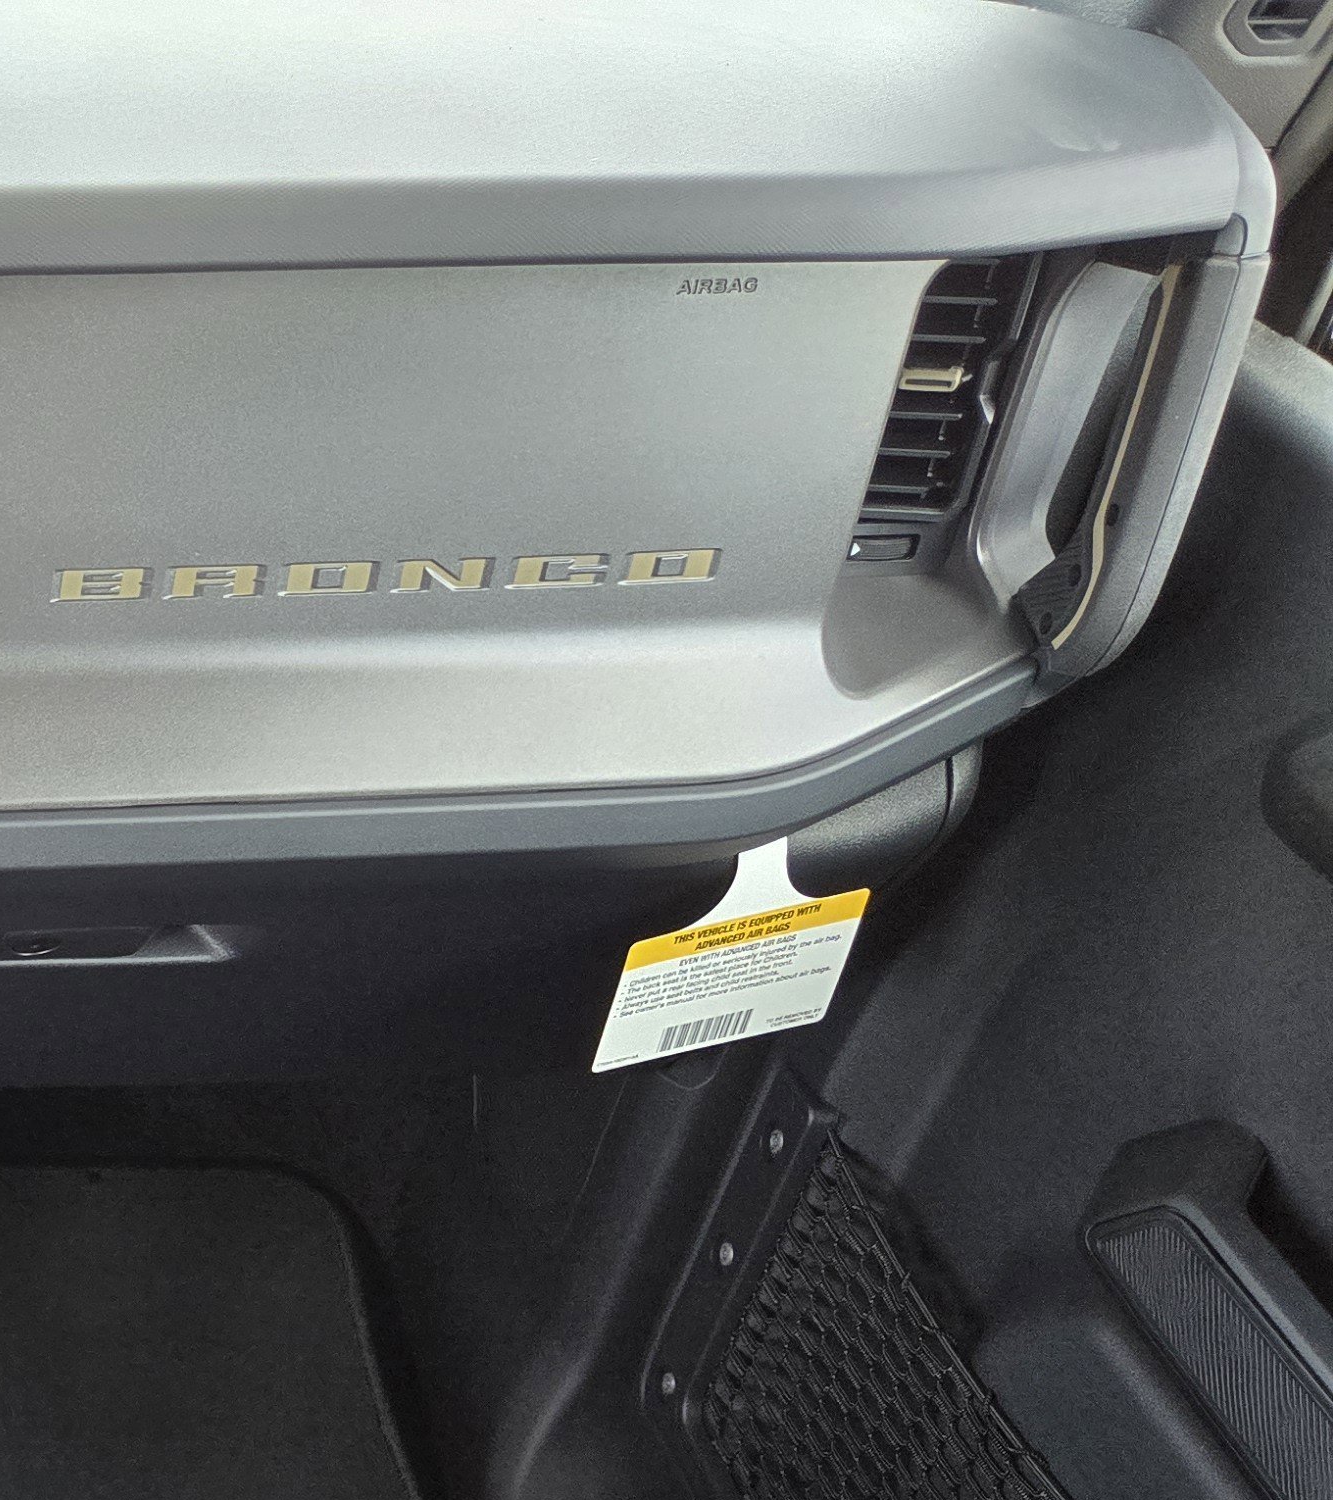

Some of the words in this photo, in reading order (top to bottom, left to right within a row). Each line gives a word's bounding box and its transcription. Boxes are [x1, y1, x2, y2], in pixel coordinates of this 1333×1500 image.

[676, 277, 758, 295] AIRBAG
[49, 547, 723, 602] BRONCO
[673, 932, 694, 944] THIS
[696, 923, 734, 939] VEHICLE
[736, 920, 747, 930] IS
[749, 910, 794, 927] EQUIPPED
[796, 904, 821, 916] WITH
[695, 932, 744, 950] ADVANCED
[747, 928, 763, 938] AIR
[765, 921, 790, 934] BAGS
[679, 956, 698, 966] EVEN
[700, 951, 719, 961] WITH
[721, 942, 759, 956] ADVANCED
[762, 939, 774, 947] AIR
[776, 934, 796, 944] BAGS
